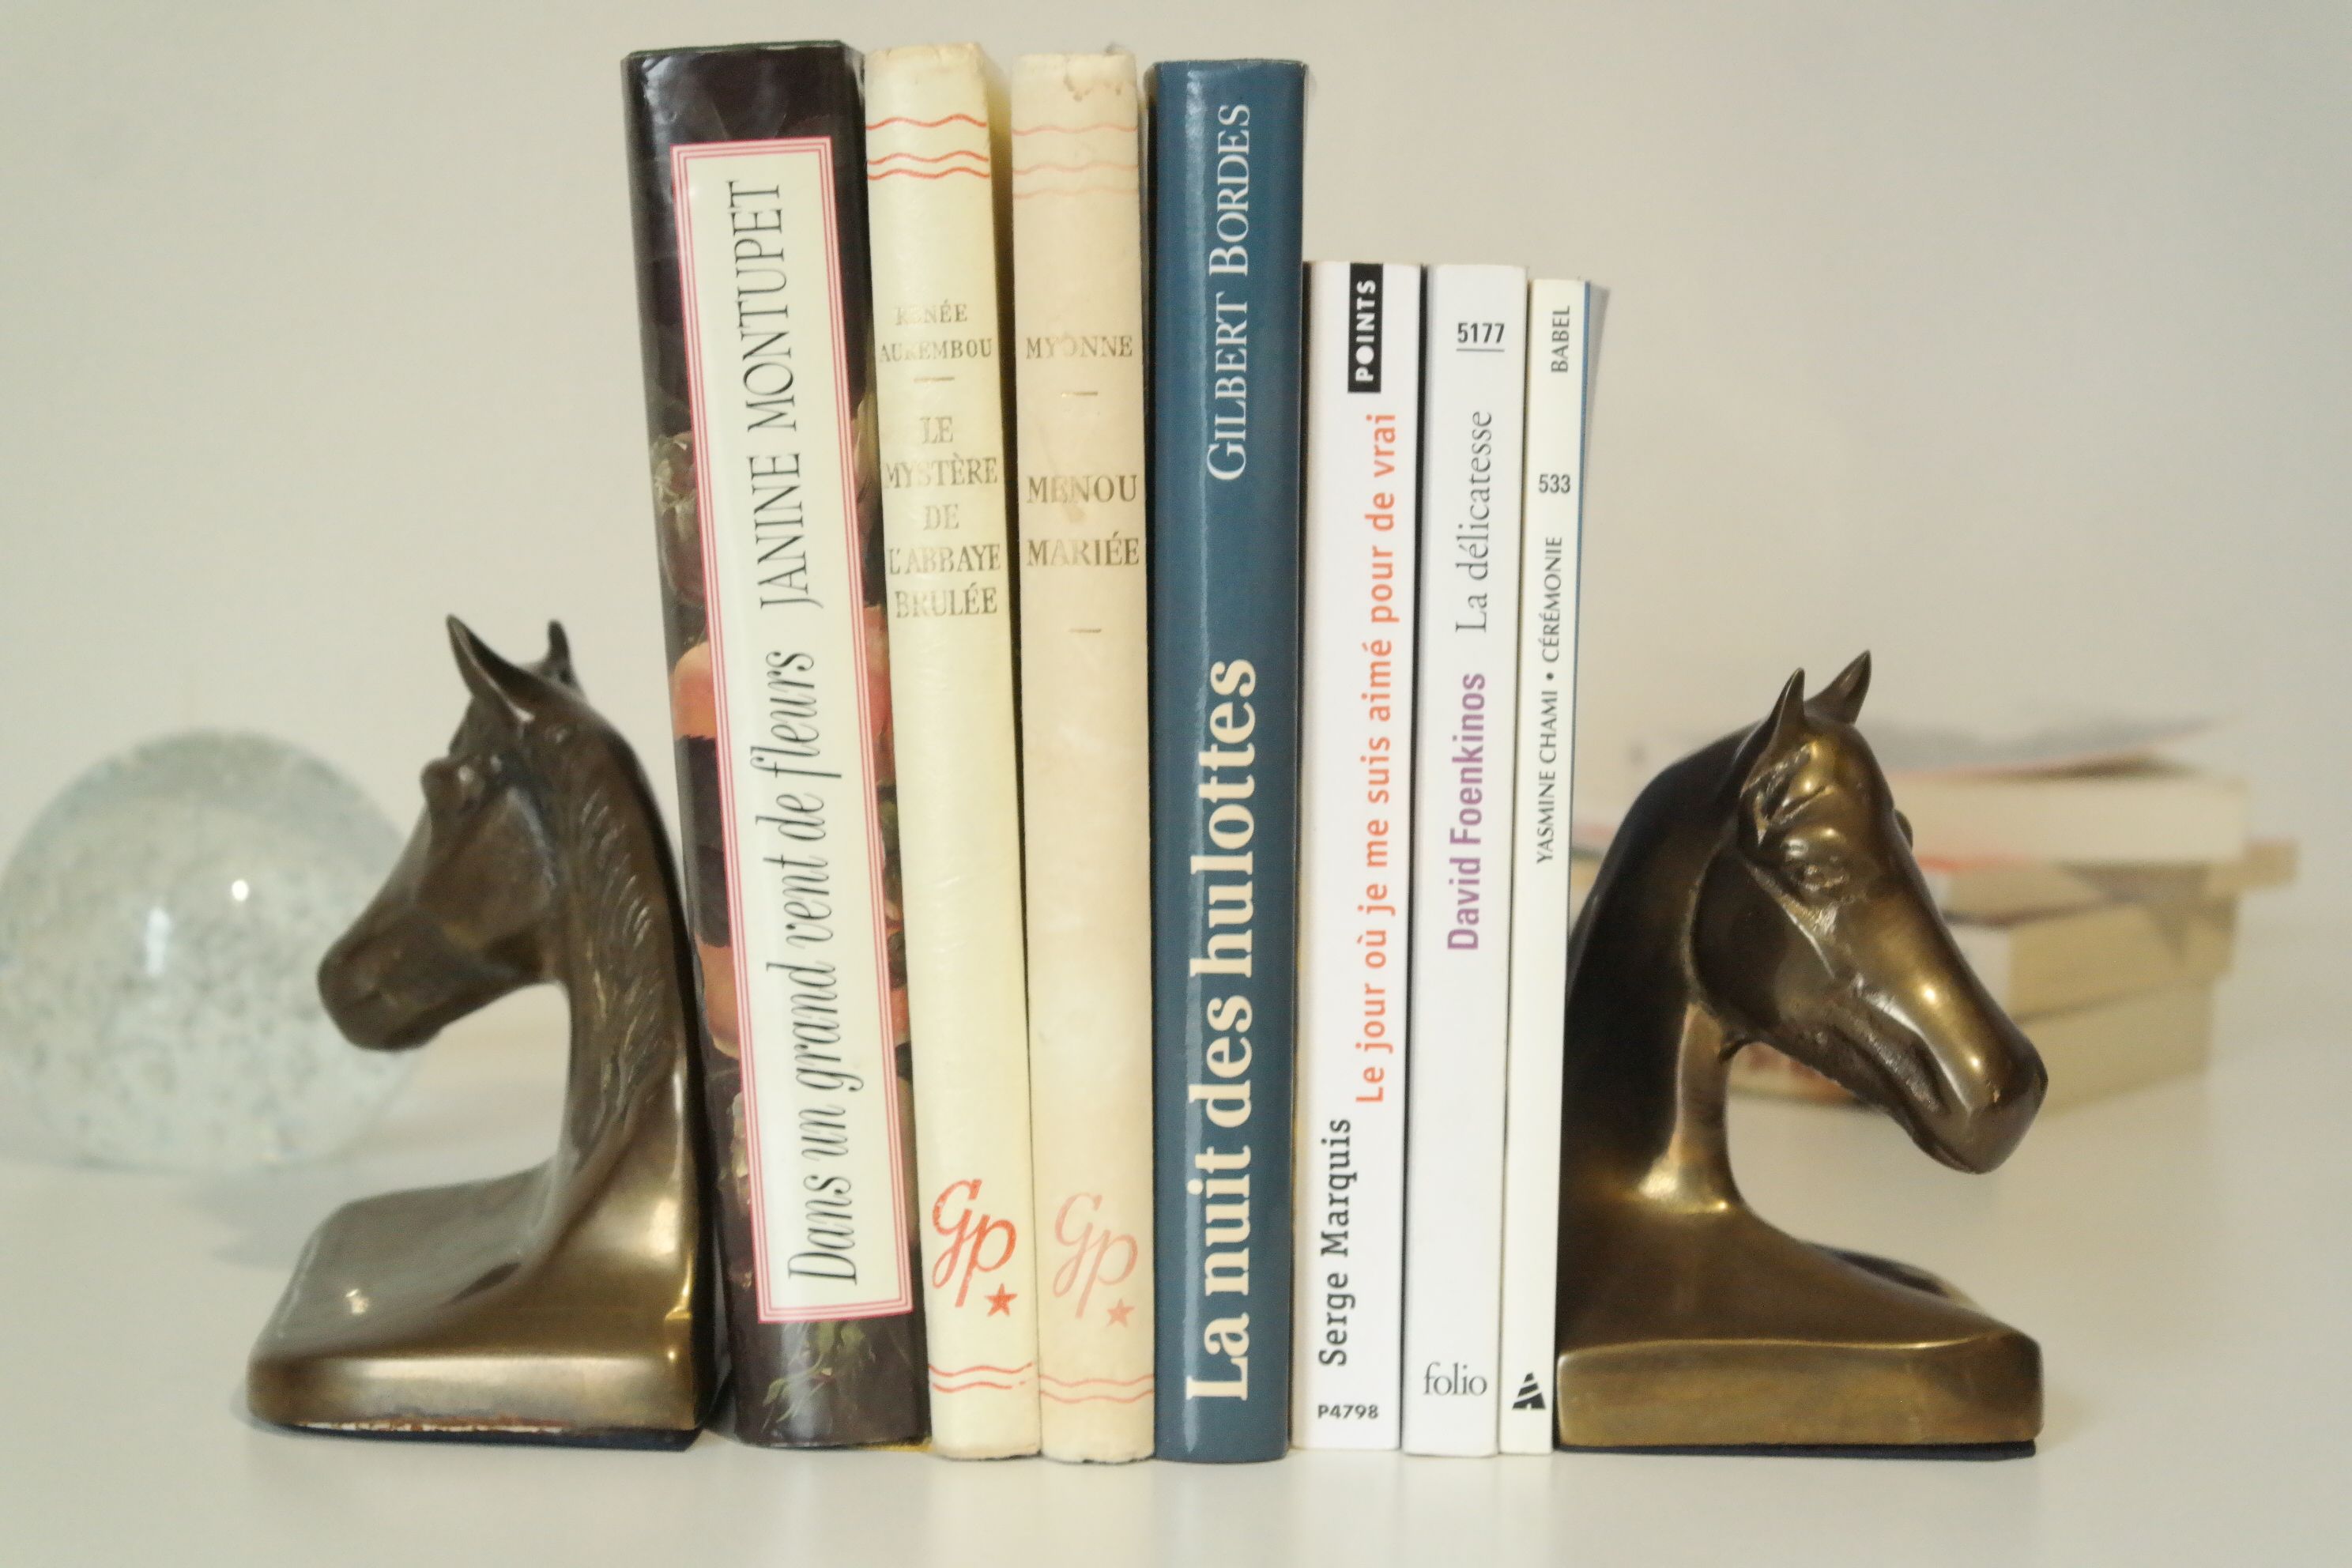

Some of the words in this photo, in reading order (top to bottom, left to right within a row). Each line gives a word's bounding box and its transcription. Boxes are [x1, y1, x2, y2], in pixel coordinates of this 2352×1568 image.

[1208, 105, 1250, 275] BORDES
[728, 180, 797, 432] MONTUPET
[895, 299, 968, 326] RNÉE
[1355, 280, 1376, 382] POINTS
[1457, 322, 1505, 344] 5177
[1551, 305, 1570, 373] BABEL
[1206, 291, 1248, 481] GILBERT
[919, 415, 954, 444] LE
[1365, 414, 1396, 478] vrai
[884, 451, 997, 489] MYSTÈRE
[1027, 474, 1138, 503] MENOU
[1455, 411, 1493, 582] délicatesse
[1539, 473, 1571, 494] 533
[748, 453, 821, 609] JANINE
[923, 503, 959, 530] DE
[1364, 492, 1395, 532] de
[888, 543, 1001, 575] L'ABBAYE
[1027, 531, 1140, 567] MARIÉE
[1370, 545, 1400, 624] pour
[894, 581, 998, 619] BRULÉE
[1455, 592, 1488, 633] La
[1538, 537, 1562, 664] CÉRÉMONIE
[750, 650, 842, 779] fleurs
[1361, 639, 1393, 722] aimé
[1449, 673, 1486, 845] Foenkinos
[1539, 691, 1558, 764] CHAMI
[1359, 736, 1391, 804] suis
[755, 793, 827, 842] de
[1189, 658, 1257, 978] hulottes
[1366, 820, 1389, 867] me
[1536, 771, 1556, 864] YASMINE
[762, 854, 834, 948] vent
[1357, 883, 1396, 917] je
[1447, 857, 1481, 950] David
[1356, 929, 1387, 969] où
[766, 962, 865, 1092] grand
[1355, 982, 1394, 1054] jour
[1188, 995, 1253, 1128] des
[1355, 1066, 1385, 1102] Le
[797, 1105, 850, 1162] un
[1187, 1145, 1251, 1297] nuit
[1320, 1119, 1358, 1257] Marquis
[788, 1174, 858, 1286] Dans
[1317, 1272, 1356, 1366] Serge
[1186, 1311, 1250, 1401] La
[1423, 1362, 1488, 1396] folio
[1317, 1404, 1379, 1419] P4798
